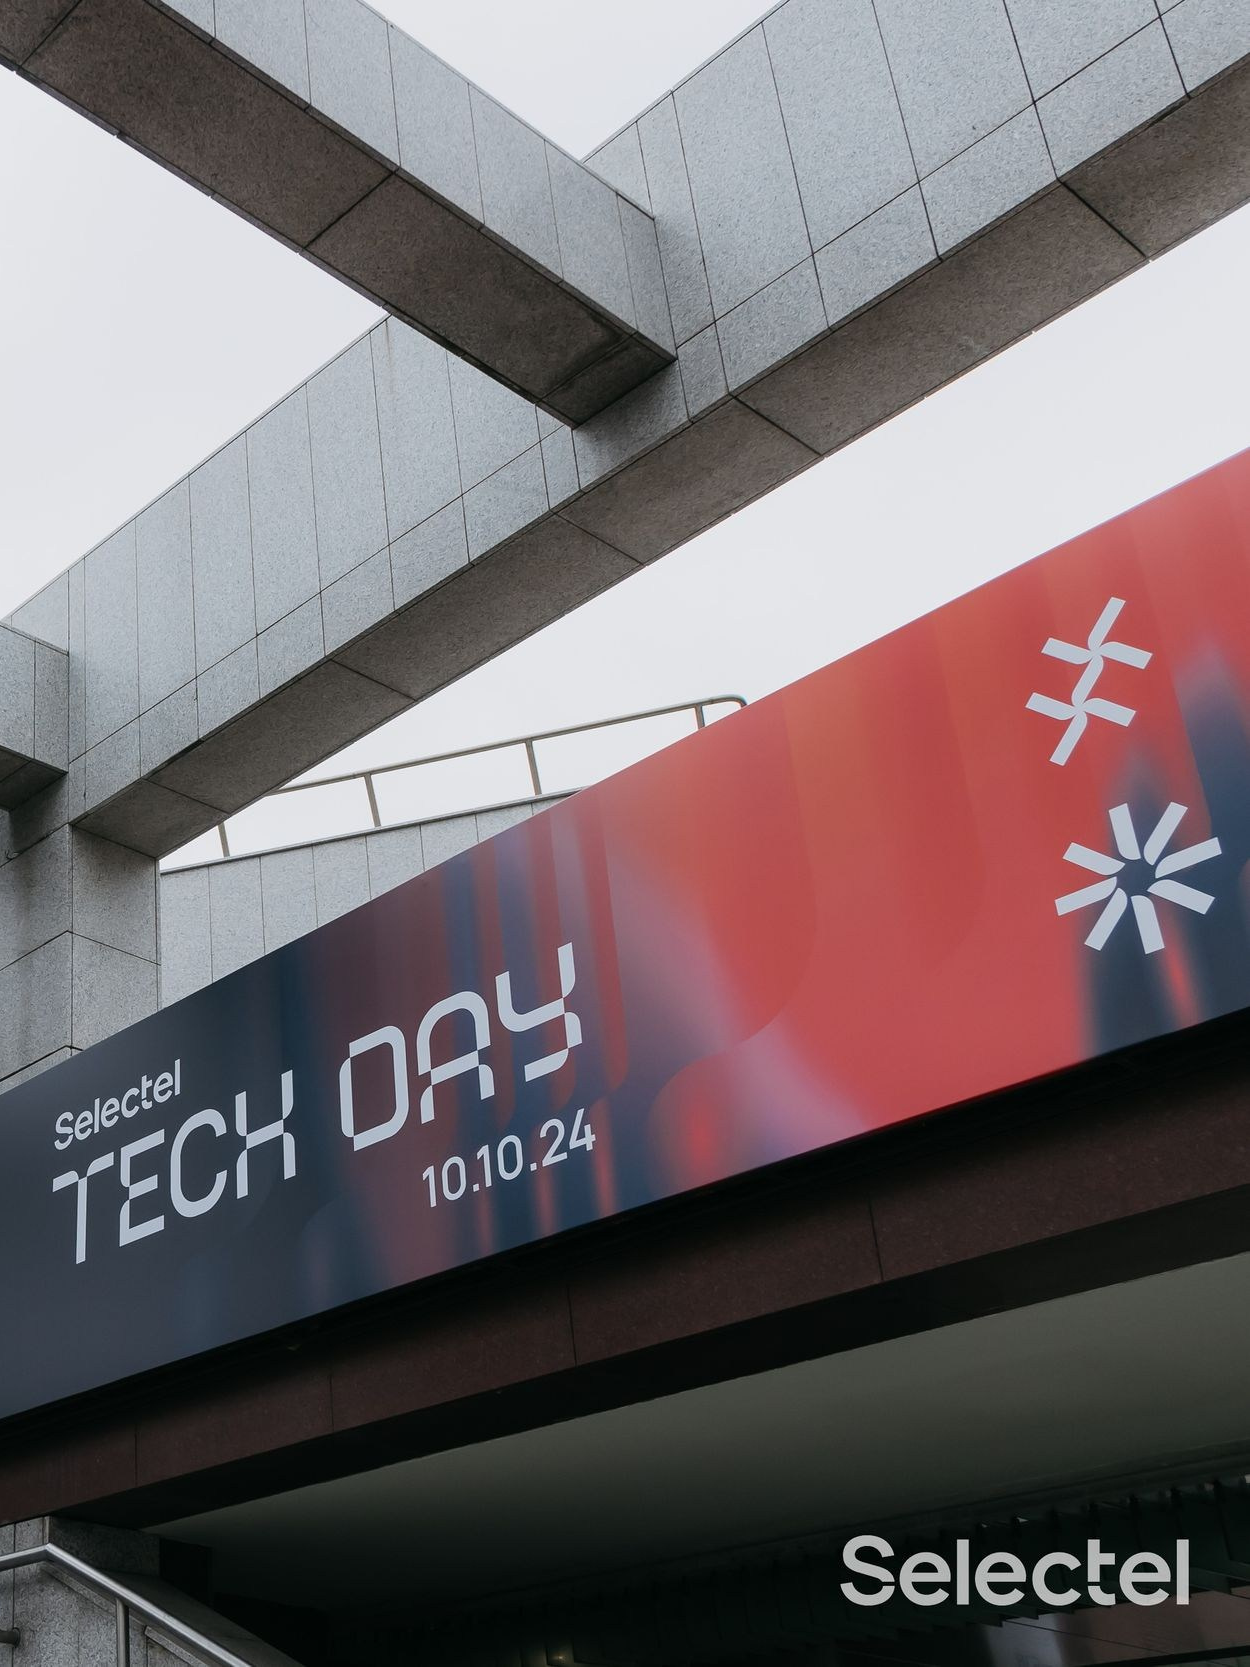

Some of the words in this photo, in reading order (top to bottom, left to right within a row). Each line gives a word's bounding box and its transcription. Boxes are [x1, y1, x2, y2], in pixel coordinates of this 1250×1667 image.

[52, 1069, 296, 1265] TECH
[339, 942, 583, 1152] DAY
[54, 1058, 181, 1151] Selectel
[421, 1108, 597, 1208] 10.10.24
